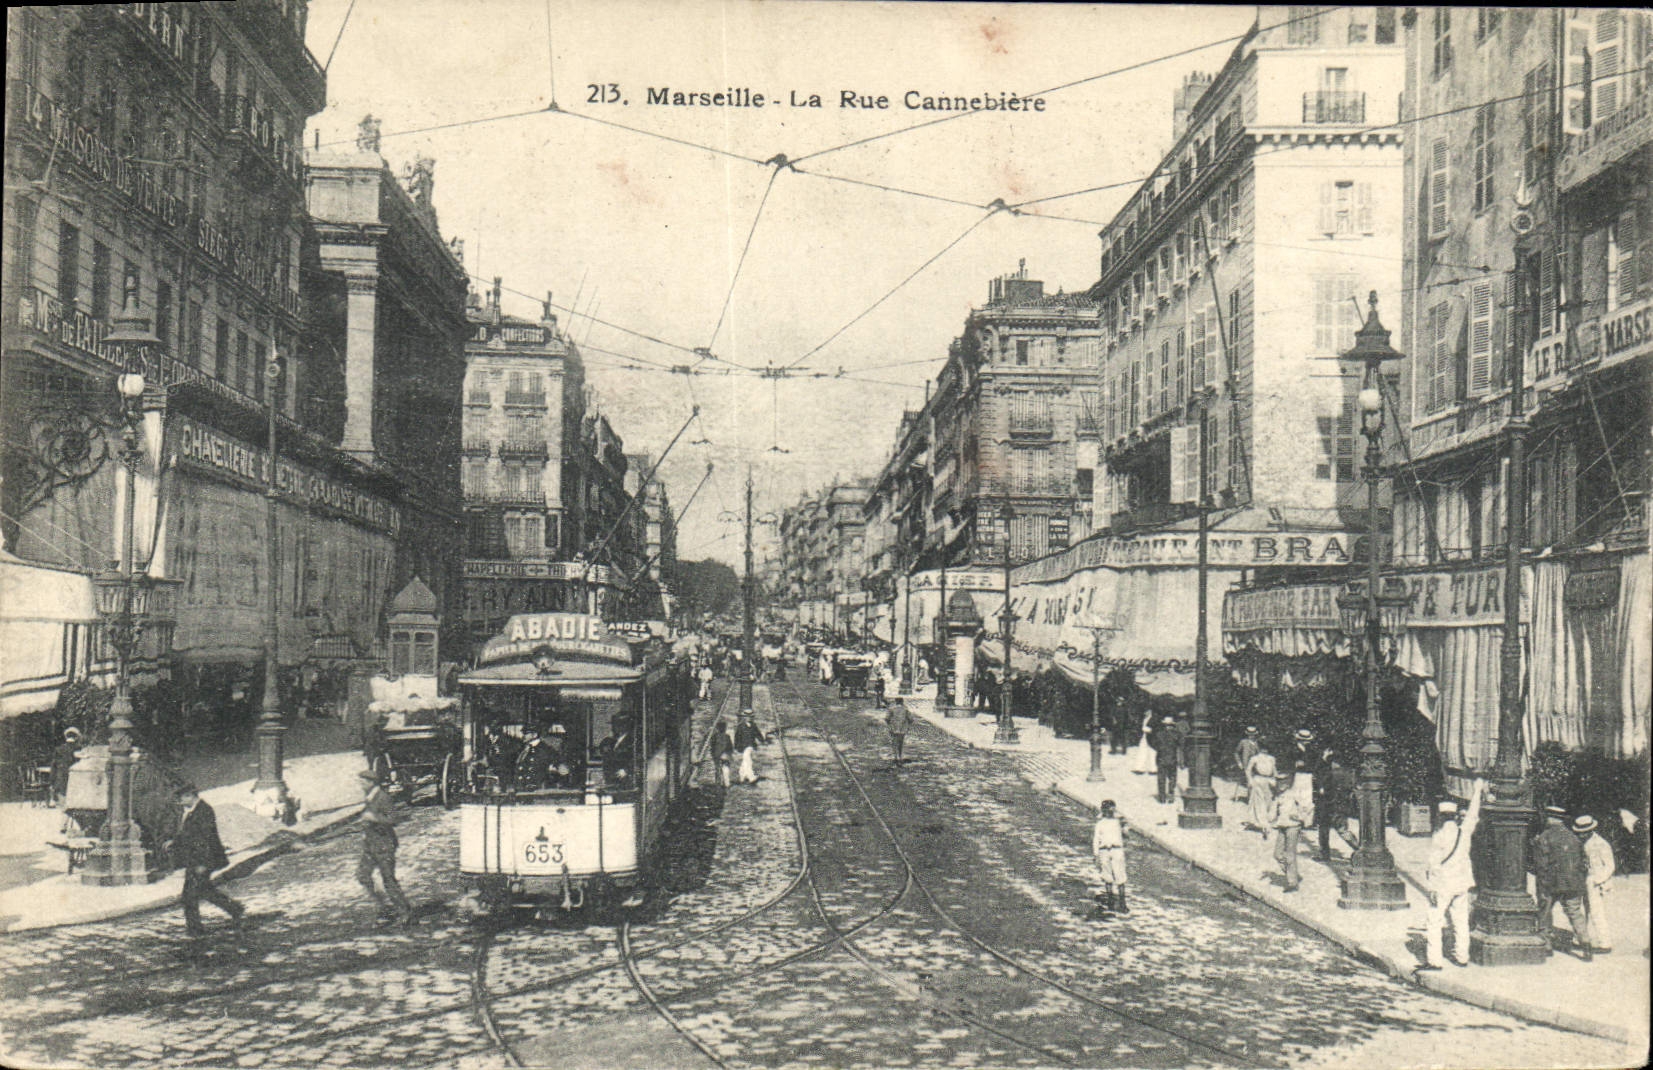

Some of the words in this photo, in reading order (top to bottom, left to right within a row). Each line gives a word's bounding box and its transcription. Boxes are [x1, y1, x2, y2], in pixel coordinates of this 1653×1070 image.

[50, 103, 111, 182] MAISONS
[251, 106, 298, 180] HOTEL
[510, 616, 602, 641] ABADIE
[525, 844, 564, 864] 653
